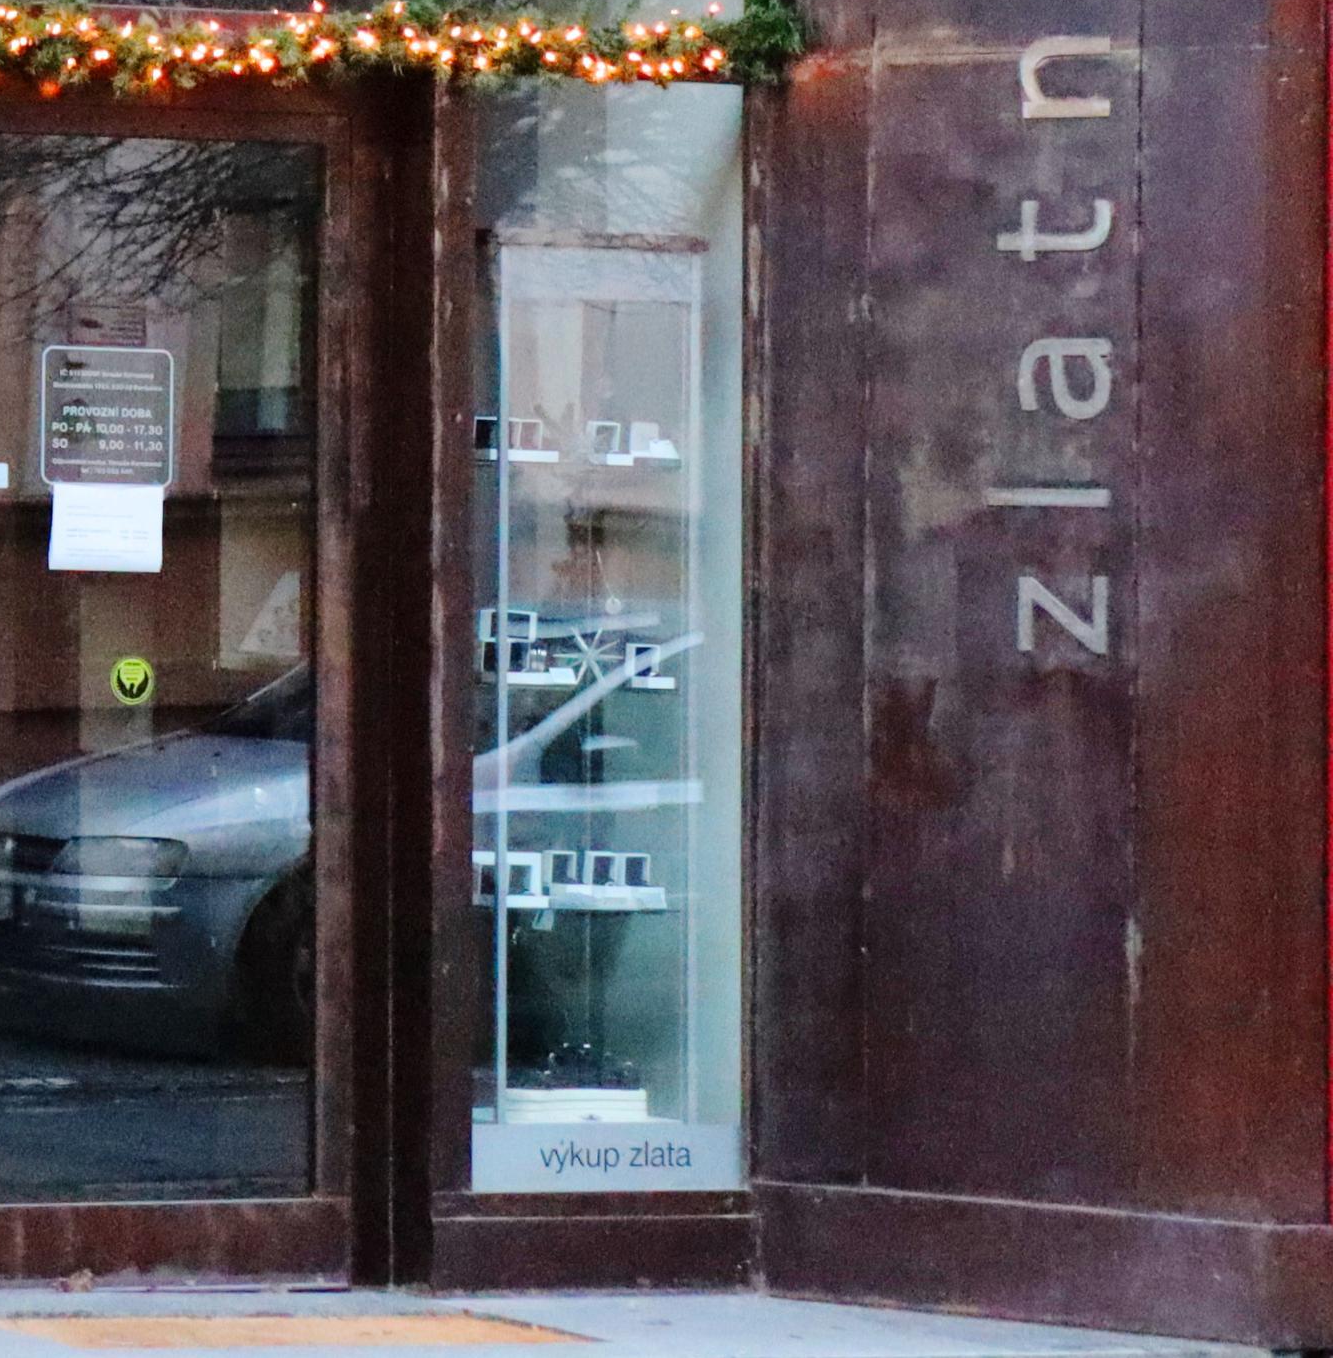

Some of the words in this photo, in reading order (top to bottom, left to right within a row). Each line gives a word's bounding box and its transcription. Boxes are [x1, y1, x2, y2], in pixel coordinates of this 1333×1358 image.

[62, 405, 119, 418] PROVOZNÍ
[121, 407, 153, 419] DOBA
[52, 438, 68, 449] SO
[540, 1140, 620, 1173] výkup
[629, 1140, 692, 1168] zlata
